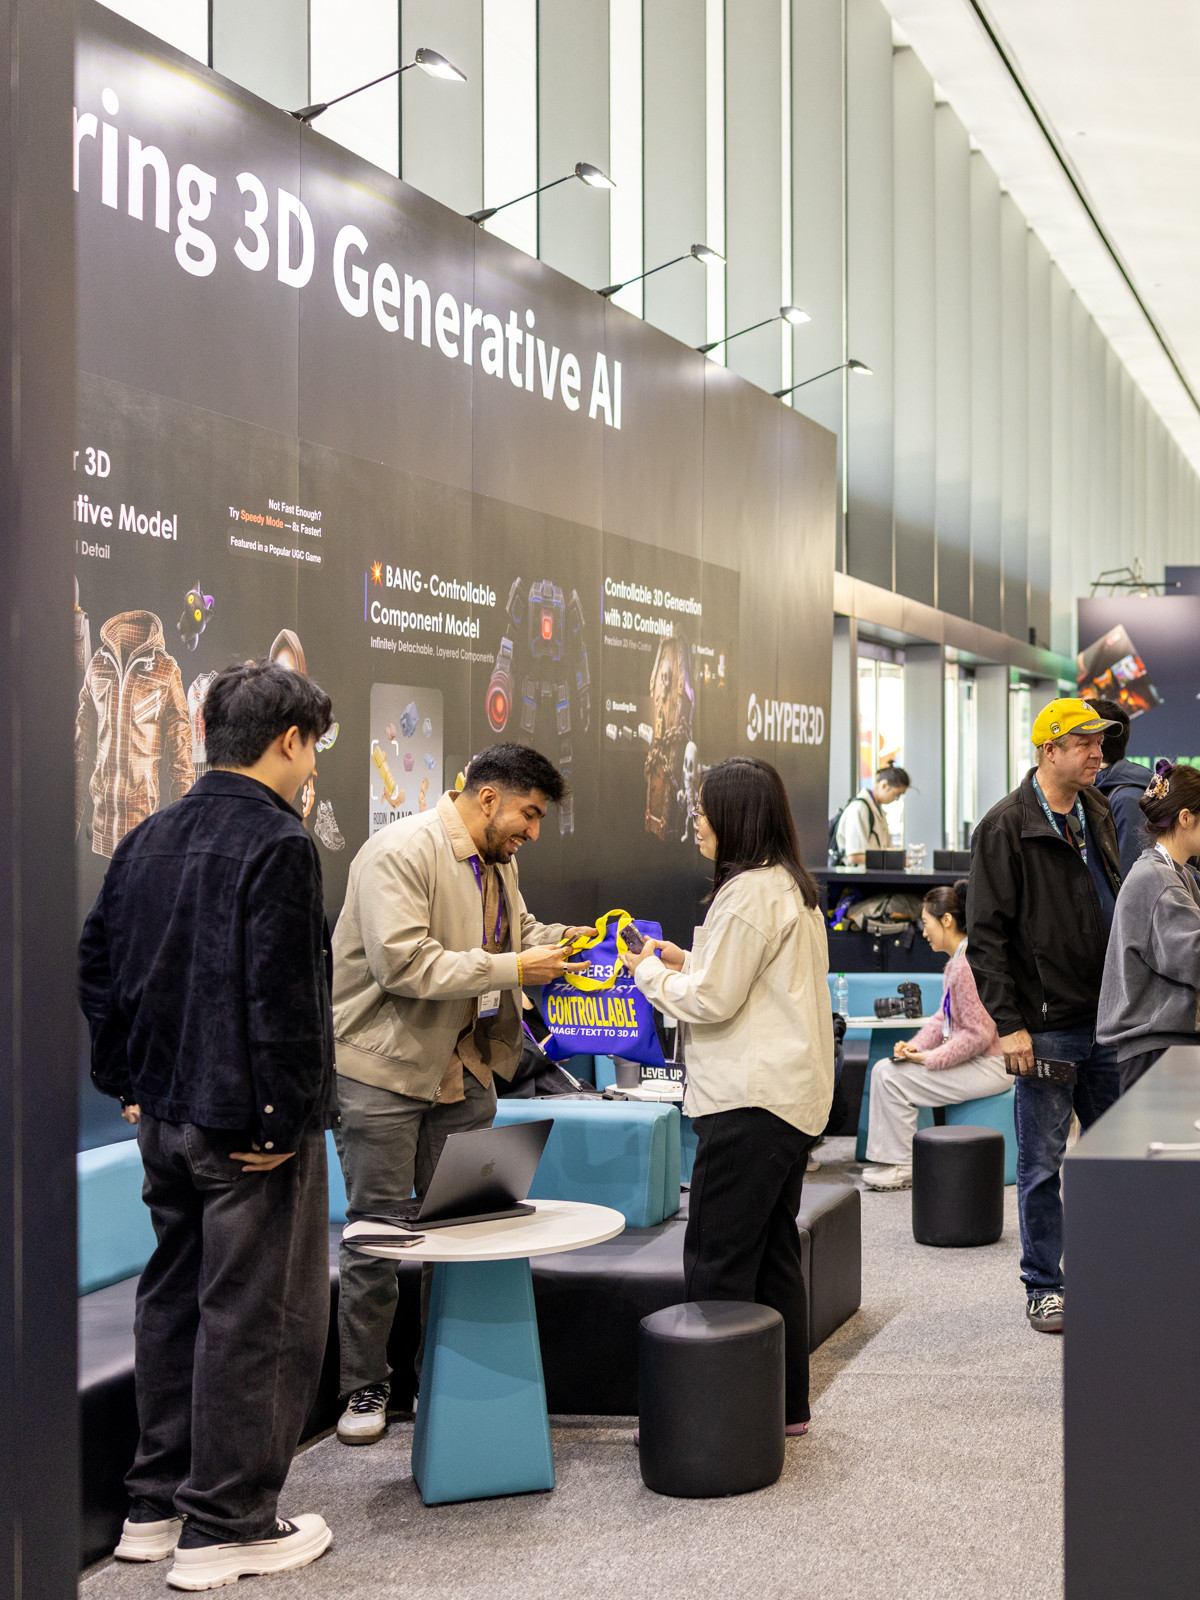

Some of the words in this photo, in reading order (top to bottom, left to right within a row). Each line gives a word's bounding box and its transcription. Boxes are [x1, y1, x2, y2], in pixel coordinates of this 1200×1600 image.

[234, 172, 315, 288] 3D
[333, 224, 581, 411] Generative
[588, 351, 622, 430] AI
[84, 446, 111, 478] 3D
[73, 494, 114, 528] tive
[118, 503, 178, 541] Model
[229, 506, 240, 521] Try
[240, 509, 265, 526] Speedy
[265, 515, 284, 528] Mode
[292, 521, 300, 532] 8x
[300, 523, 322, 537] Faster!
[268, 498, 280, 511] Not
[281, 501, 295, 515] Fast
[295, 505, 322, 522] Enough?
[82, 541, 110, 558] Detail
[230, 535, 257, 550] Featured
[257, 541, 263, 551] in
[269, 543, 291, 557] Popular
[291, 548, 305, 560] UGC
[305, 551, 322, 563] Game
[386, 565, 422, 592] BANG
[429, 574, 497, 607] Controllable
[604, 576, 652, 605] Controllable
[652, 588, 663, 607] 3D
[664, 591, 703, 616] Generation
[370, 600, 443, 633] Component
[444, 613, 480, 639] Model
[604, 607, 621, 628] with
[622, 610, 633, 630] 3D
[633, 613, 674, 638] ControlNet
[370, 635, 397, 654] Infinitely
[398, 639, 435, 657] Detachable,
[436, 645, 460, 659] Layered
[460, 650, 495, 664] Components
[763, 699, 825, 746] HYPER3D
[547, 994, 638, 1028] CONTROLLABLE
[603, 1029, 616, 1037] TO
[617, 1029, 629, 1037] 3D
[629, 1029, 639, 1038] AI
[641, 1067, 669, 1080] LEVEL
[669, 1068, 683, 1081] UP
